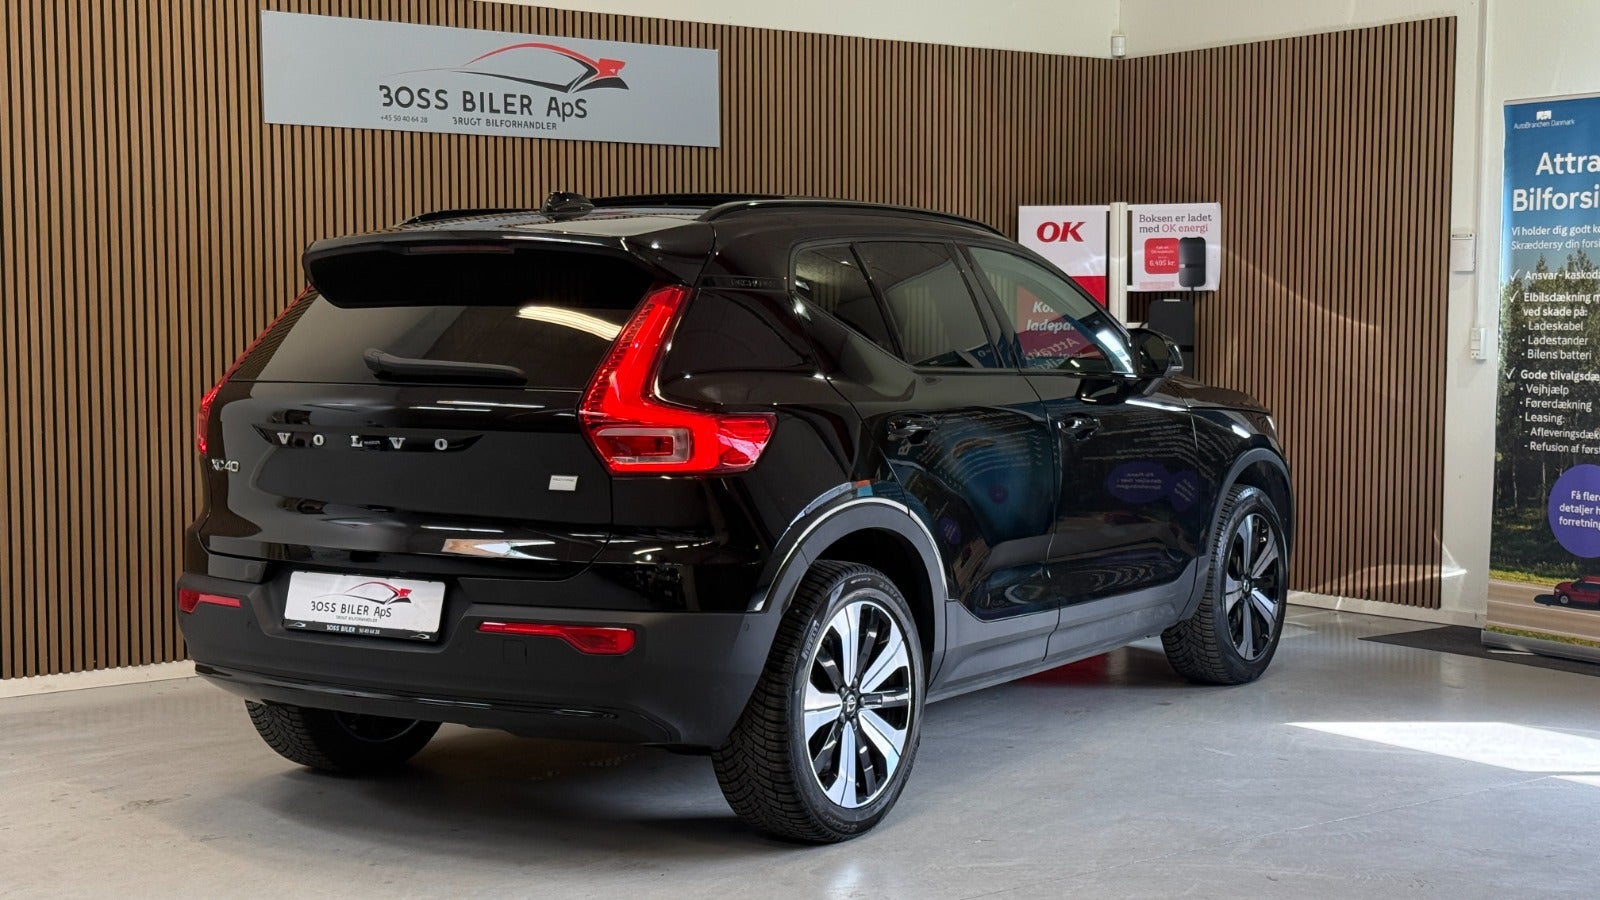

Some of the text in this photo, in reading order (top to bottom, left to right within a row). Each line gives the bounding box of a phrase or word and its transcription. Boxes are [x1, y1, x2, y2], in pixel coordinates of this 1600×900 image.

[462, 90, 533, 116] BILER
[546, 96, 588, 122] ApS
[485, 118, 557, 130] BILFORHANDLER
[1513, 118, 1575, 130] AutoBranchen Danmark
[1139, 214, 1173, 223] Boksen
[1187, 213, 1212, 222] ladet
[1036, 221, 1086, 243] OK
[1139, 223, 1209, 235] med OK energi
[1511, 226, 1520, 236] Vi
[1521, 225, 1550, 236] holder
[1552, 225, 1568, 238] dig
[1569, 224, 1591, 237] godt
[1511, 239, 1563, 252] Skræddersy
[1565, 239, 1580, 249] din
[1523, 291, 1592, 305] Elbilsdækning
[1523, 306, 1588, 319] ved skade på:
[1528, 320, 1584, 331] Ladeskabel
[1527, 335, 1589, 346] Ladestander
[1527, 349, 1592, 361] Bilens batteri
[1520, 369, 1548, 380] Gode
[1525, 383, 1570, 397] Vejhjælp
[1525, 397, 1593, 413] Førerdækning
[276, 432, 449, 450] VOLVO
[1529, 440, 1569, 454] Refusion
[1570, 442, 1581, 455] af
[1571, 490, 1581, 500] Få
[1559, 503, 1594, 516] detaljer
[340, 603, 370, 616] BILER
[373, 605, 392, 620] ApS
